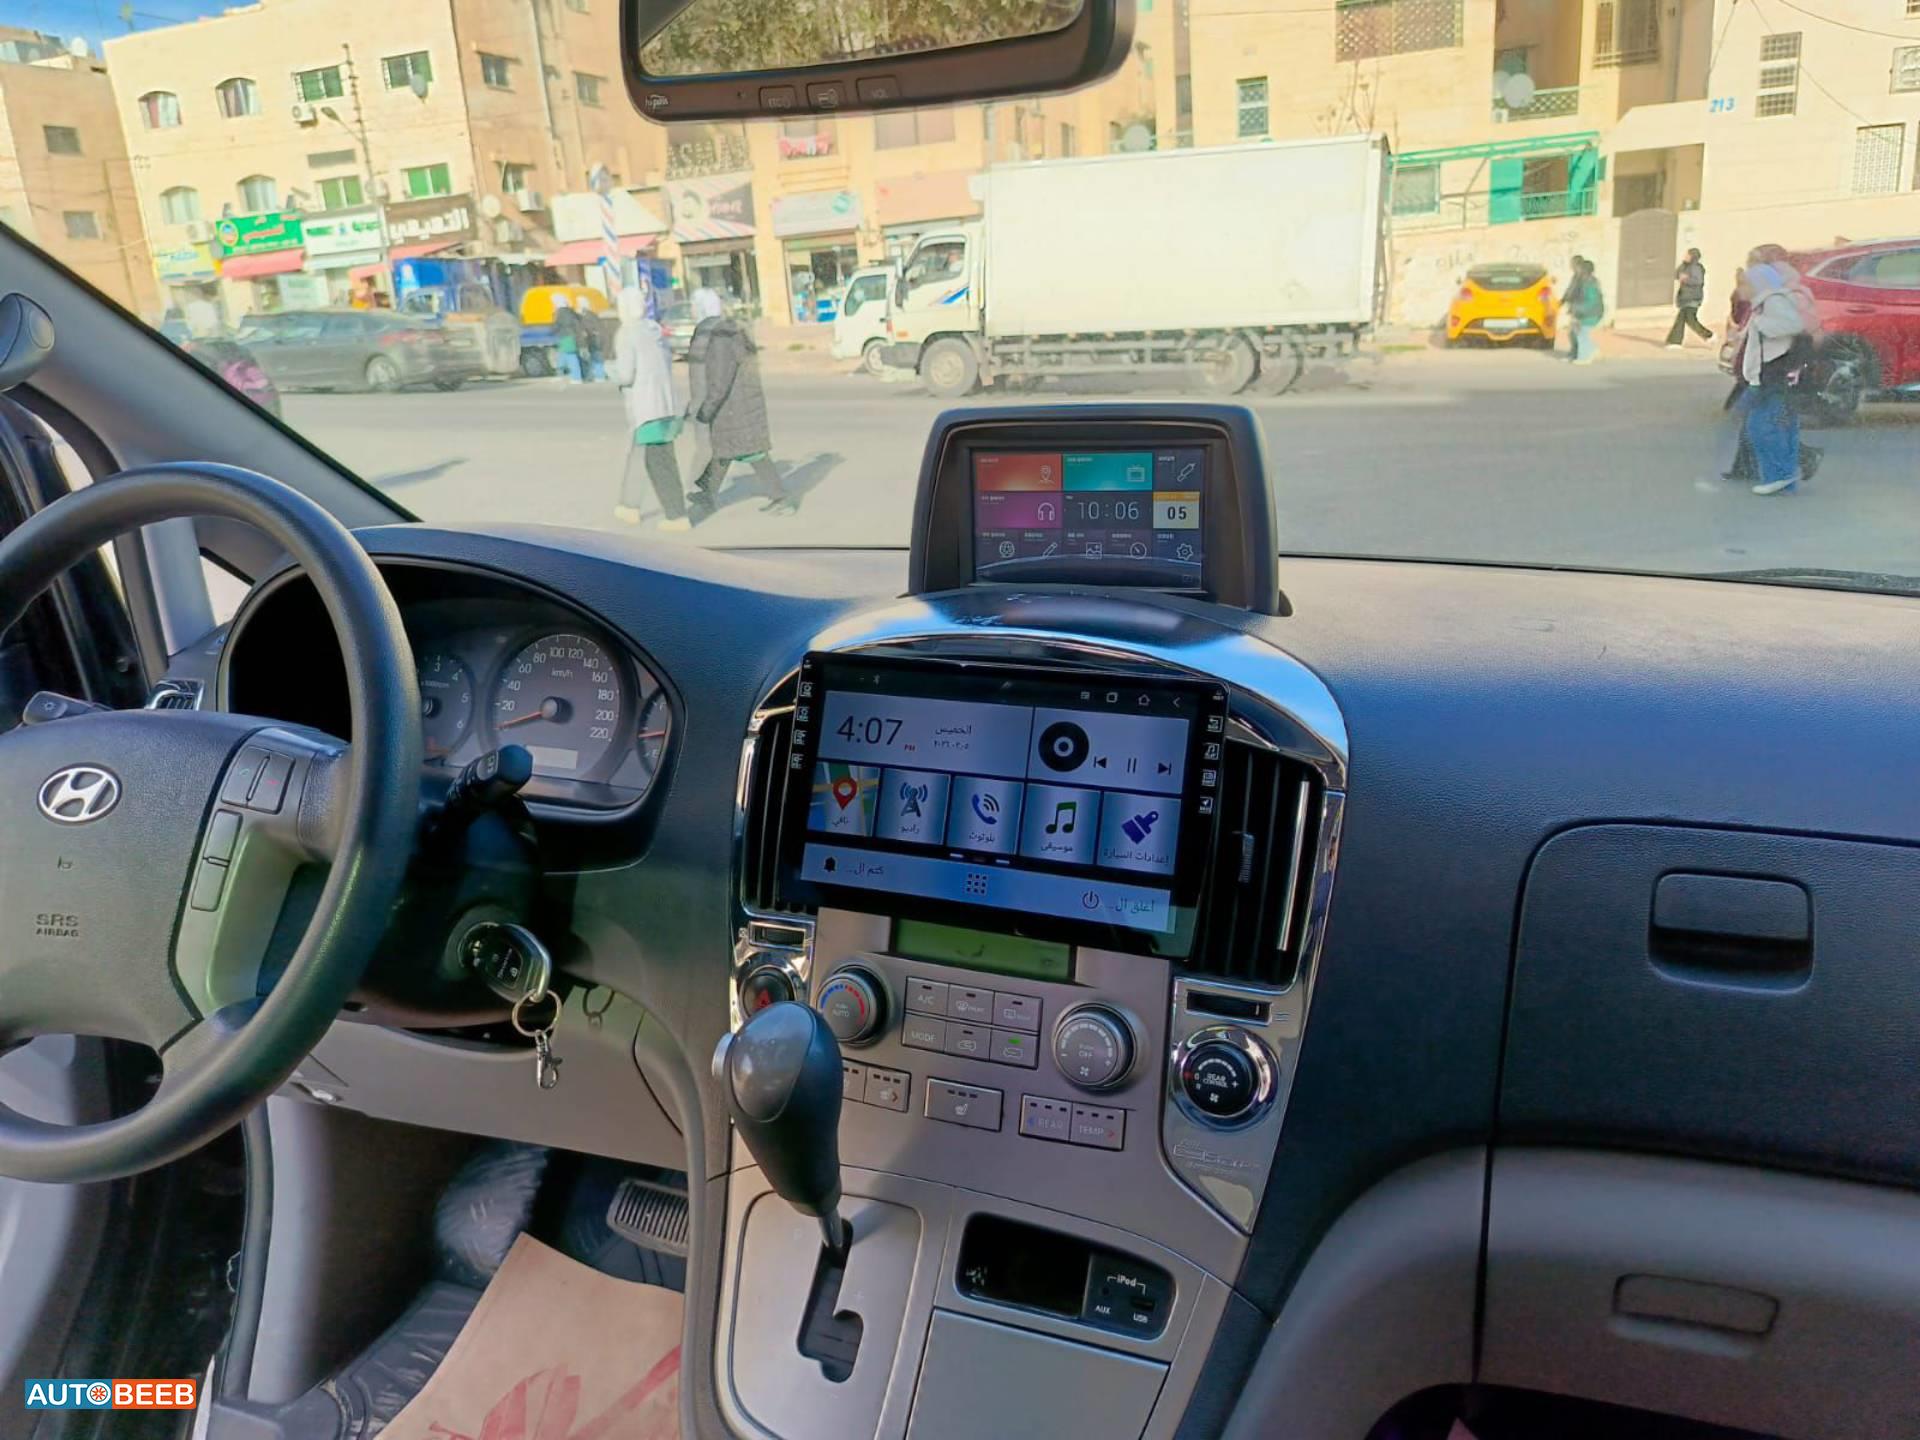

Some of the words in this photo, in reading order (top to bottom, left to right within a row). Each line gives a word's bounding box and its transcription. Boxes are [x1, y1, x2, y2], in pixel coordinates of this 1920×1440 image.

[1709, 97, 1736, 113] 213
[1167, 506, 1187, 520] 05
[533, 653, 546, 664] 80
[549, 647, 565, 658] 100
[567, 647, 584, 658] 120
[518, 663, 532, 674] 60
[583, 658, 599, 669] 140
[551, 668, 574, 680] km/h
[592, 671, 608, 683] 160
[508, 680, 521, 691] 40
[597, 688, 614, 700] 180
[501, 700, 515, 711] 20
[595, 709, 614, 721] 200
[588, 726, 609, 738] 220
[836, 715, 903, 746] 4:07
[934, 724, 972, 736] الخميس
[899, 824, 920, 835] راديو
[968, 832, 996, 844] بلوتوث
[1103, 846, 1133, 860] السيارة
[36, 913, 79, 927] SRS
[36, 927, 79, 937] AIRBAG
[917, 994, 935, 1006] A/C
[1078, 1123, 1105, 1135] TEMP
[1116, 1273, 1137, 1288] iPod
[1095, 1304, 1111, 1315] AUX
[1132, 1312, 1149, 1324] USB
